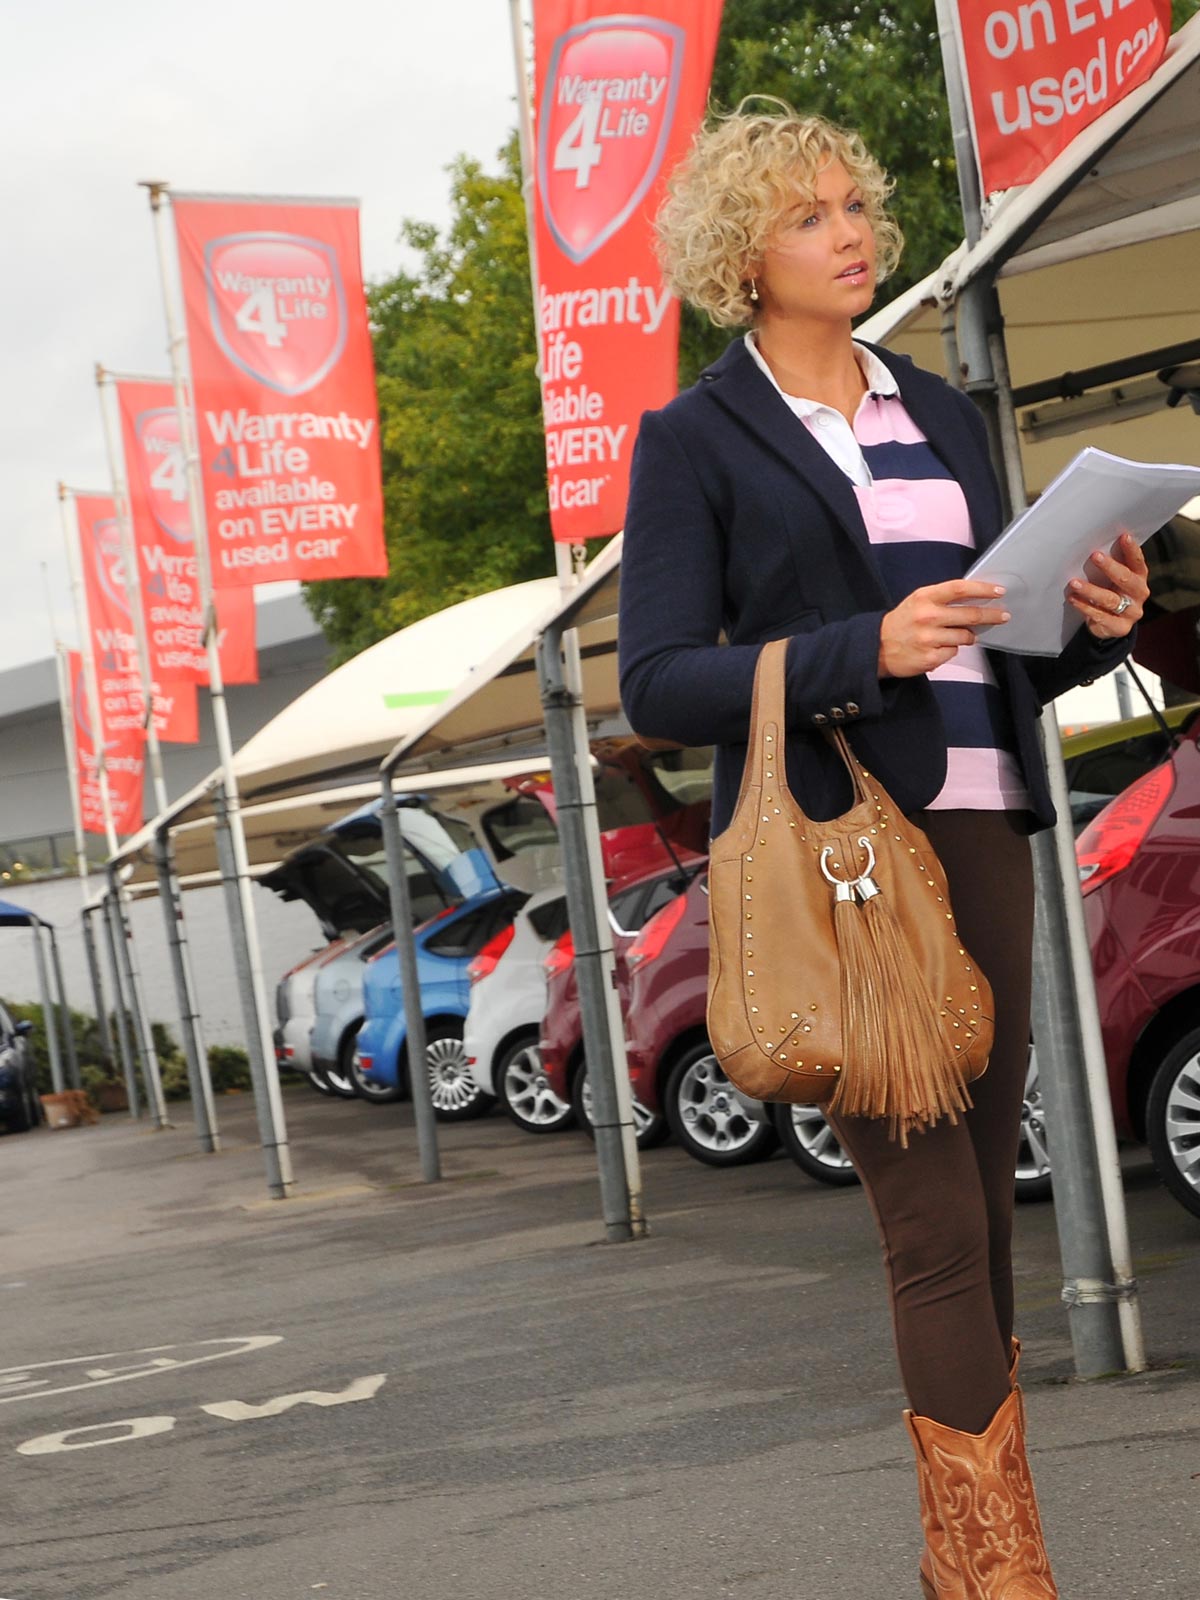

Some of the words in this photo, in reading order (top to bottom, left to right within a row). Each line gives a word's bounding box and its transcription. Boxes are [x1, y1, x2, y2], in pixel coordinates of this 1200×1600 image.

[985, 0, 1056, 60] on
[558, 71, 667, 107] Warranty
[991, 38, 1107, 135] used
[553, 86, 603, 188] 4
[600, 106, 649, 139] Life
[216, 271, 332, 299] Warranty
[235, 281, 288, 347] 4
[278, 297, 327, 320] Life
[541, 277, 671, 334] arranty
[205, 408, 374, 449] Warranty
[211, 446, 237, 478] 4
[237, 439, 309, 478] Life
[215, 475, 336, 511] available
[561, 477, 606, 509] car
[218, 516, 256, 540] on
[260, 503, 359, 535] EVERY
[221, 536, 290, 569] used
[295, 537, 341, 561] car
